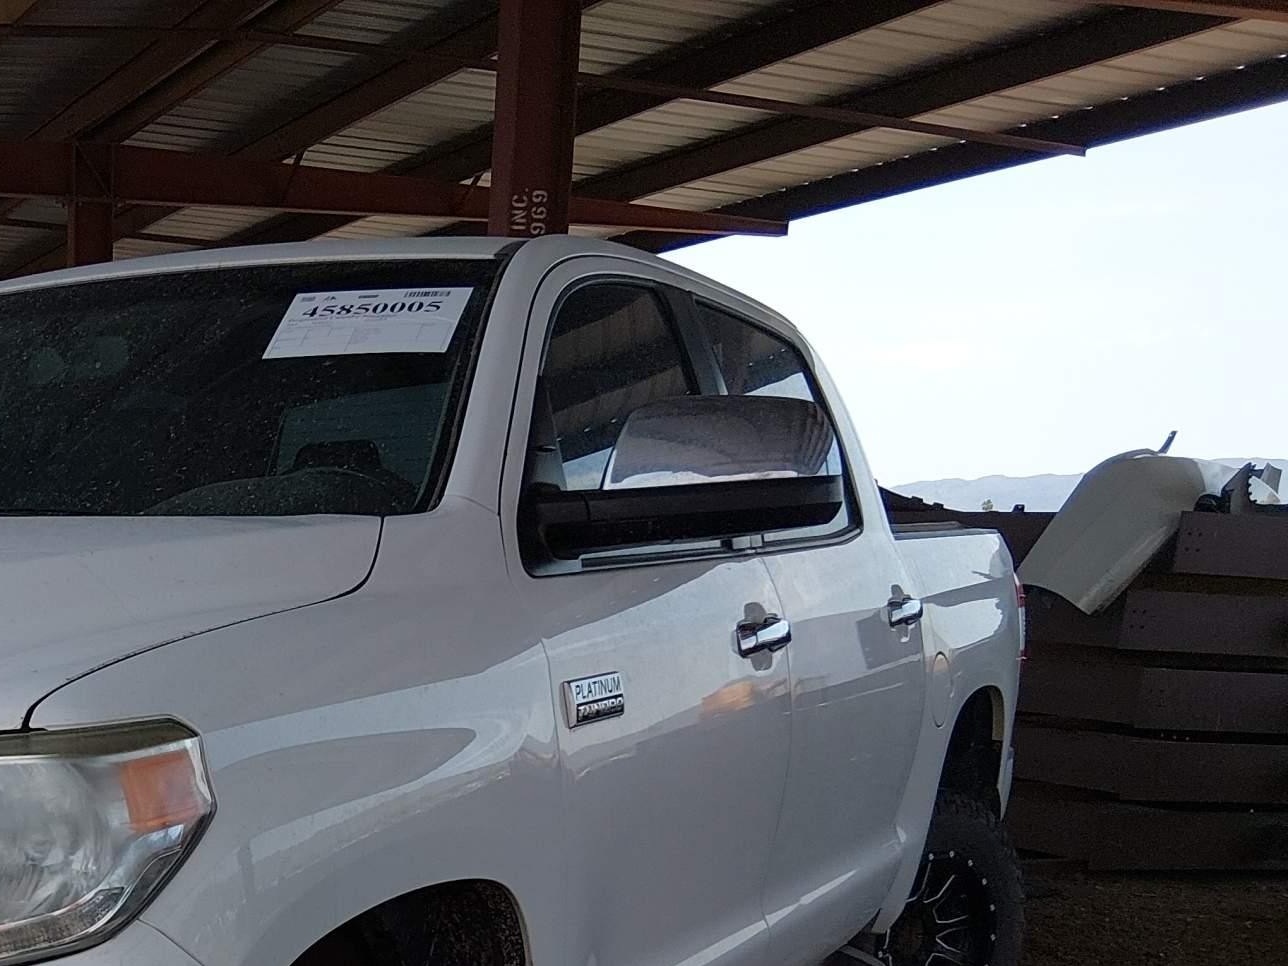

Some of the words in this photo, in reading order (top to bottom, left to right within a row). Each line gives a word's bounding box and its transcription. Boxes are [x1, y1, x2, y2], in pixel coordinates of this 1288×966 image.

[511, 188, 528, 230] INC.
[302, 301, 443, 317] 45850005
[575, 675, 621, 699] PLATINUM
